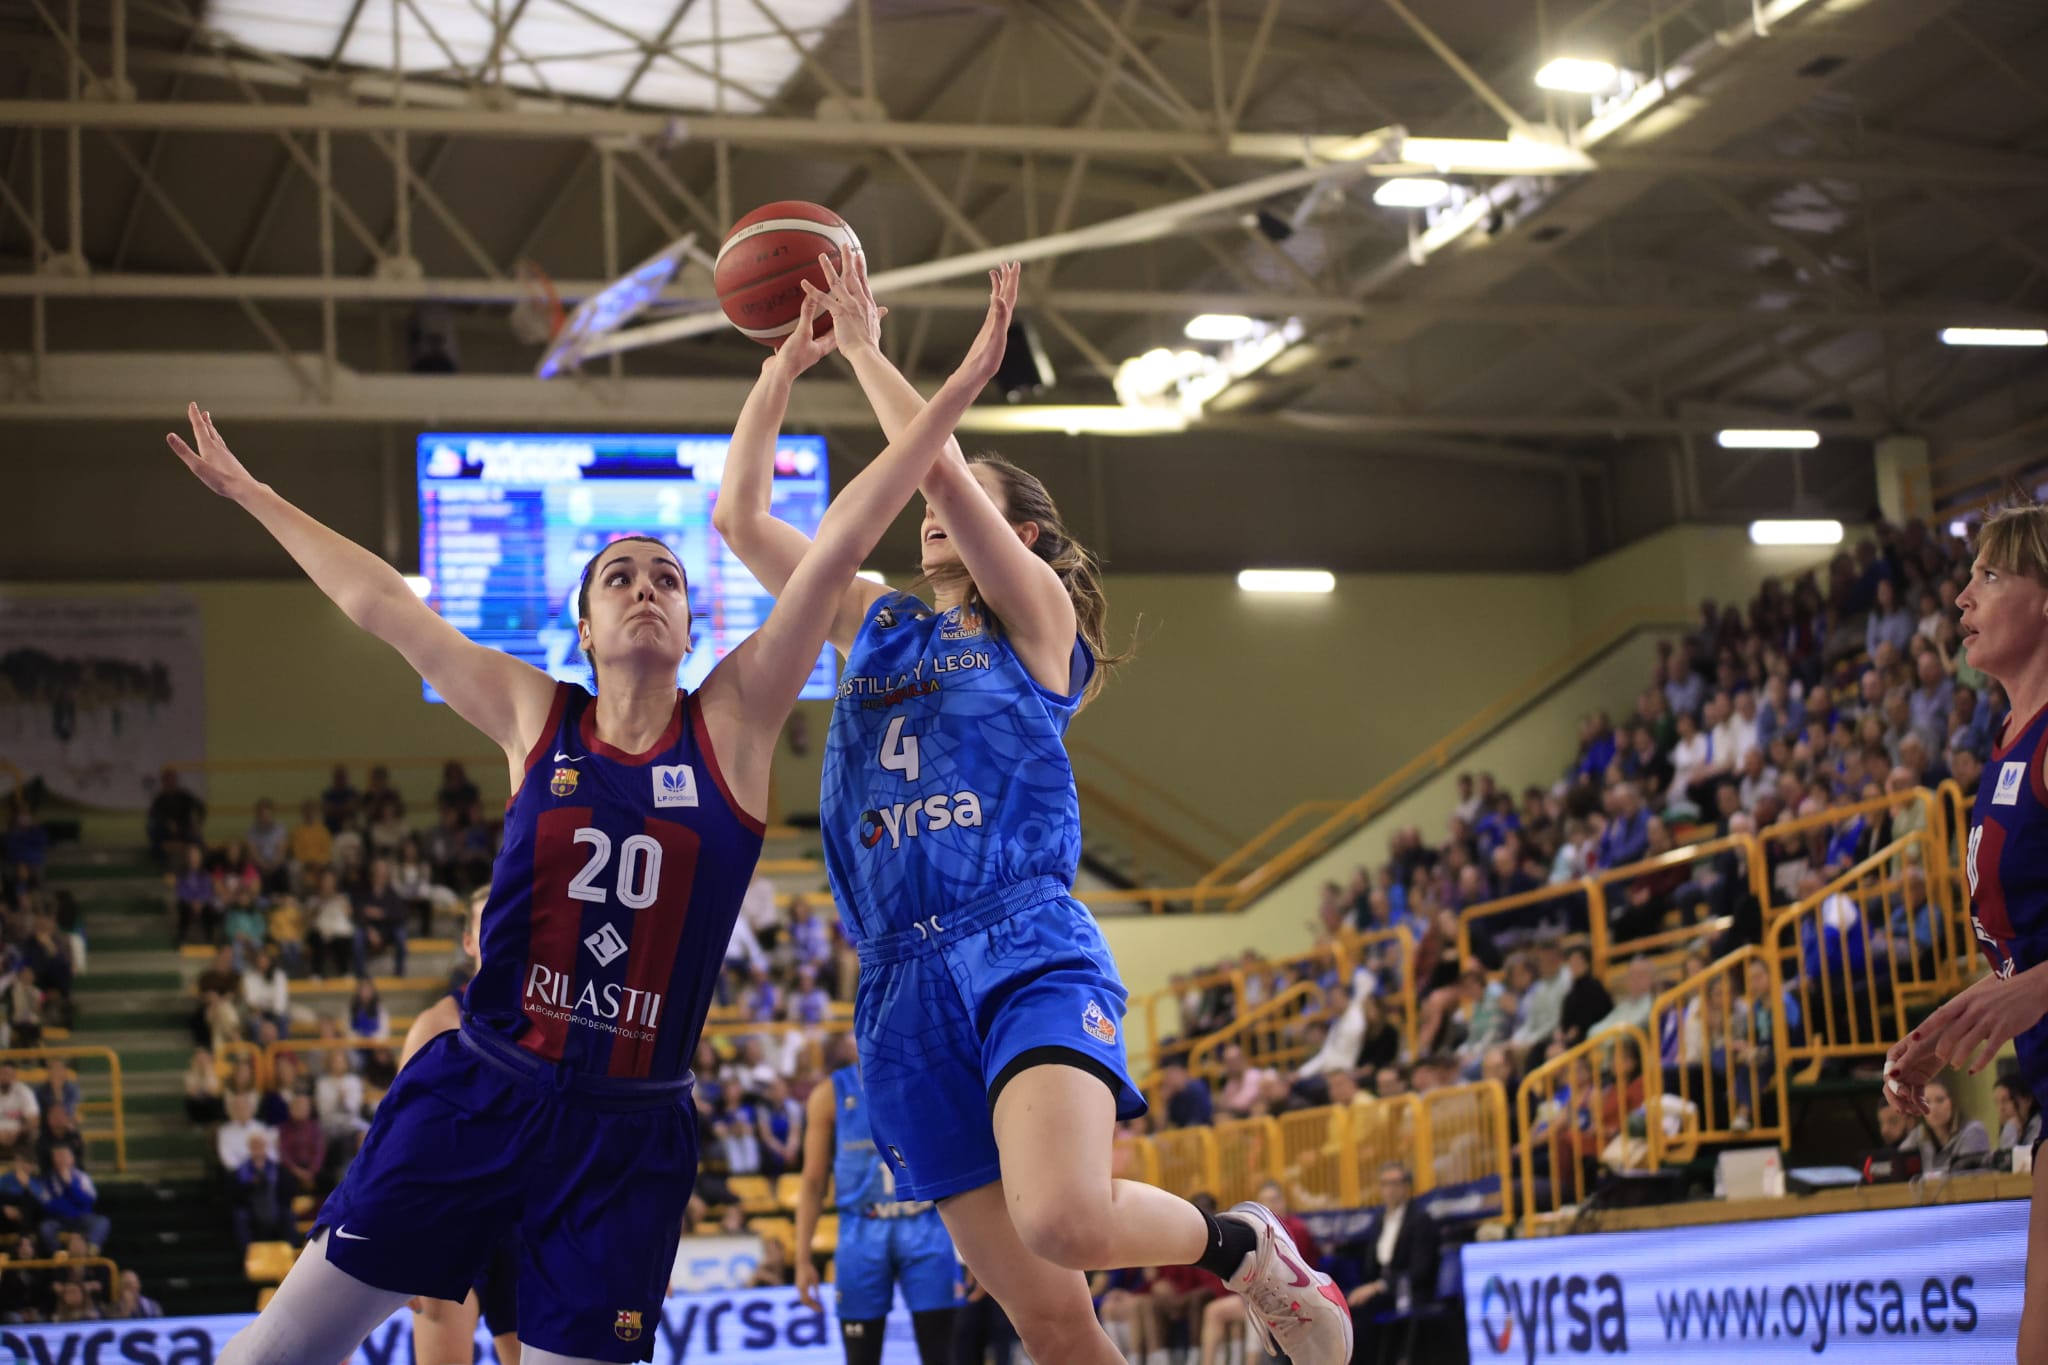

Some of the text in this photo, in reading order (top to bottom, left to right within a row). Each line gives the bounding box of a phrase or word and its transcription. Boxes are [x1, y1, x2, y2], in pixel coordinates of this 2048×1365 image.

[913, 659, 924, 681] Y
[933, 649, 990, 674] LEÓN
[880, 715, 919, 782] 4
[860, 790, 982, 849] oyrsa
[567, 827, 663, 910] 20
[524, 1002, 588, 1026] LABORATORIO
[526, 963, 661, 1028] RILASTIL
[659, 1298, 828, 1365] yrsa
[1656, 1275, 1978, 1354] www.oyrsa.es
